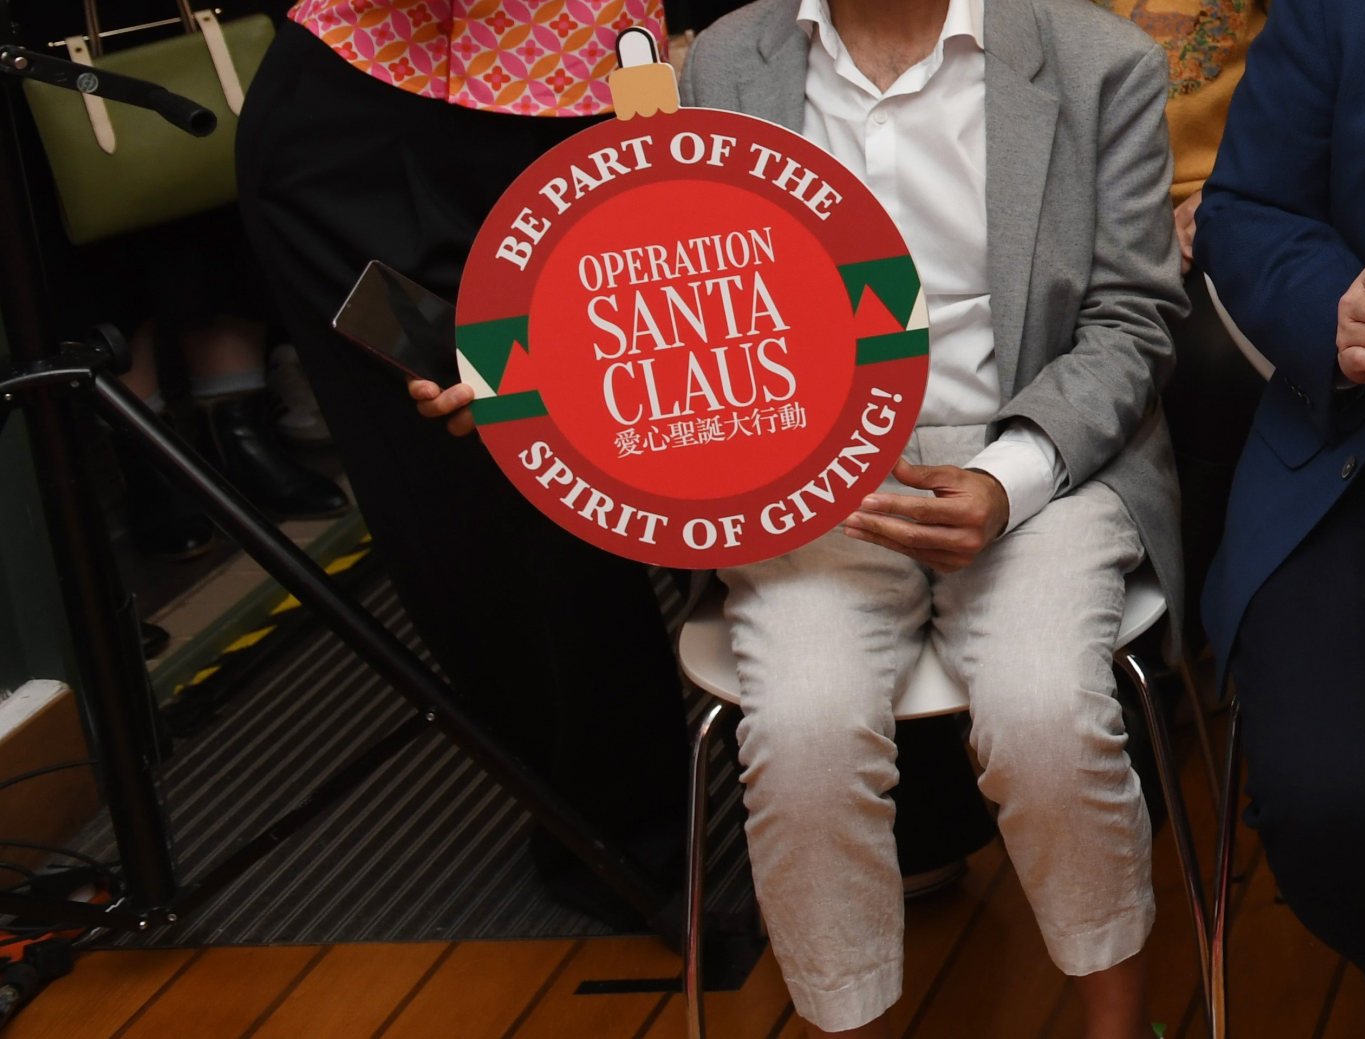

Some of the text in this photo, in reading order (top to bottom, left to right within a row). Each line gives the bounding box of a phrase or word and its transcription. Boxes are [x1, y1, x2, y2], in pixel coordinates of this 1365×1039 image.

[496, 132, 843, 270] BE PART OF THE
[578, 227, 775, 292] OPERATION
[587, 271, 790, 361] SANTA
[603, 337, 796, 426] CLAUS
[519, 387, 903, 549] SPIRIT OF GIVING!
[614, 403, 806, 459] 愛心聖誕大行動
